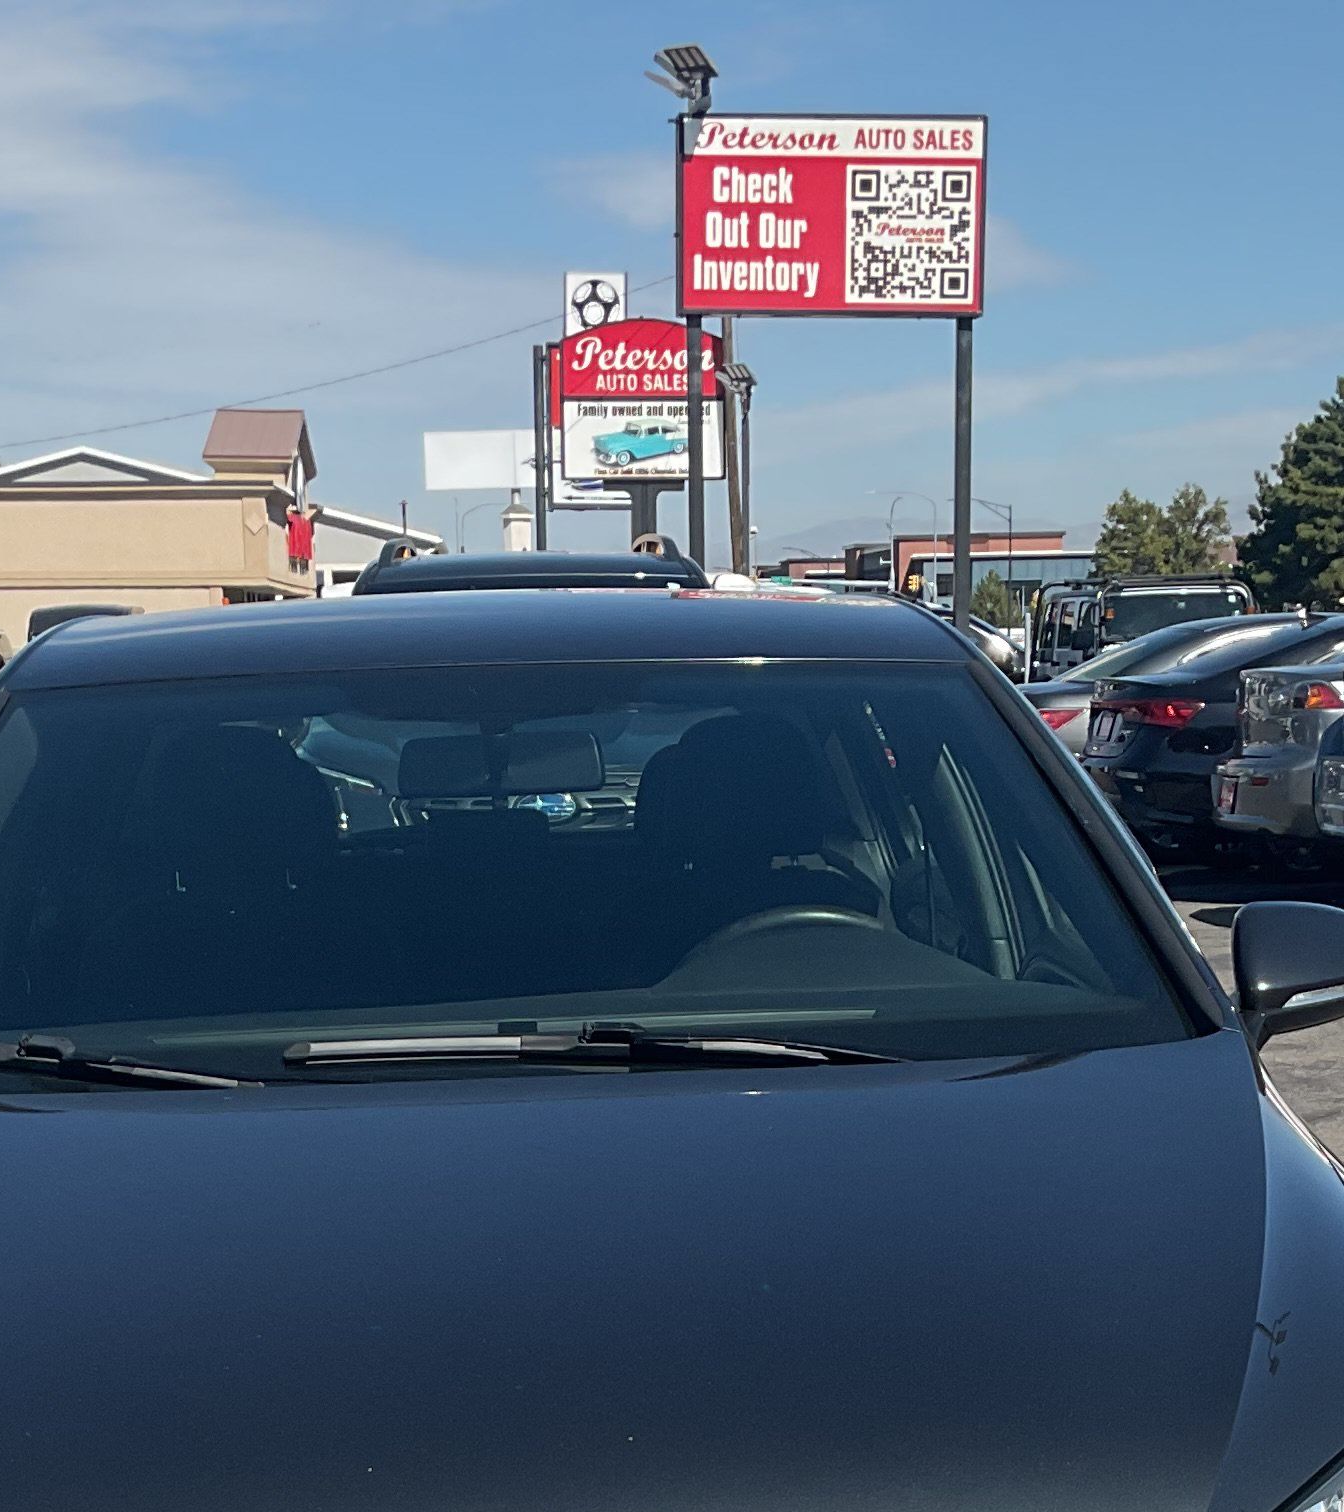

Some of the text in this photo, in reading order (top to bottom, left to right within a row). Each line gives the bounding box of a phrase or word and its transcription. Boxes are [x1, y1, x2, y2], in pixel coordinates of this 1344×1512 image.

[697, 121, 974, 151] Peterson AUTO SALES
[713, 166, 793, 204] Check
[705, 211, 808, 249] Out Our
[693, 253, 820, 298] Inventory
[596, 373, 638, 391] AUTO
[577, 403, 608, 418] Family
[612, 404, 642, 416] owned
[646, 404, 664, 416] and
